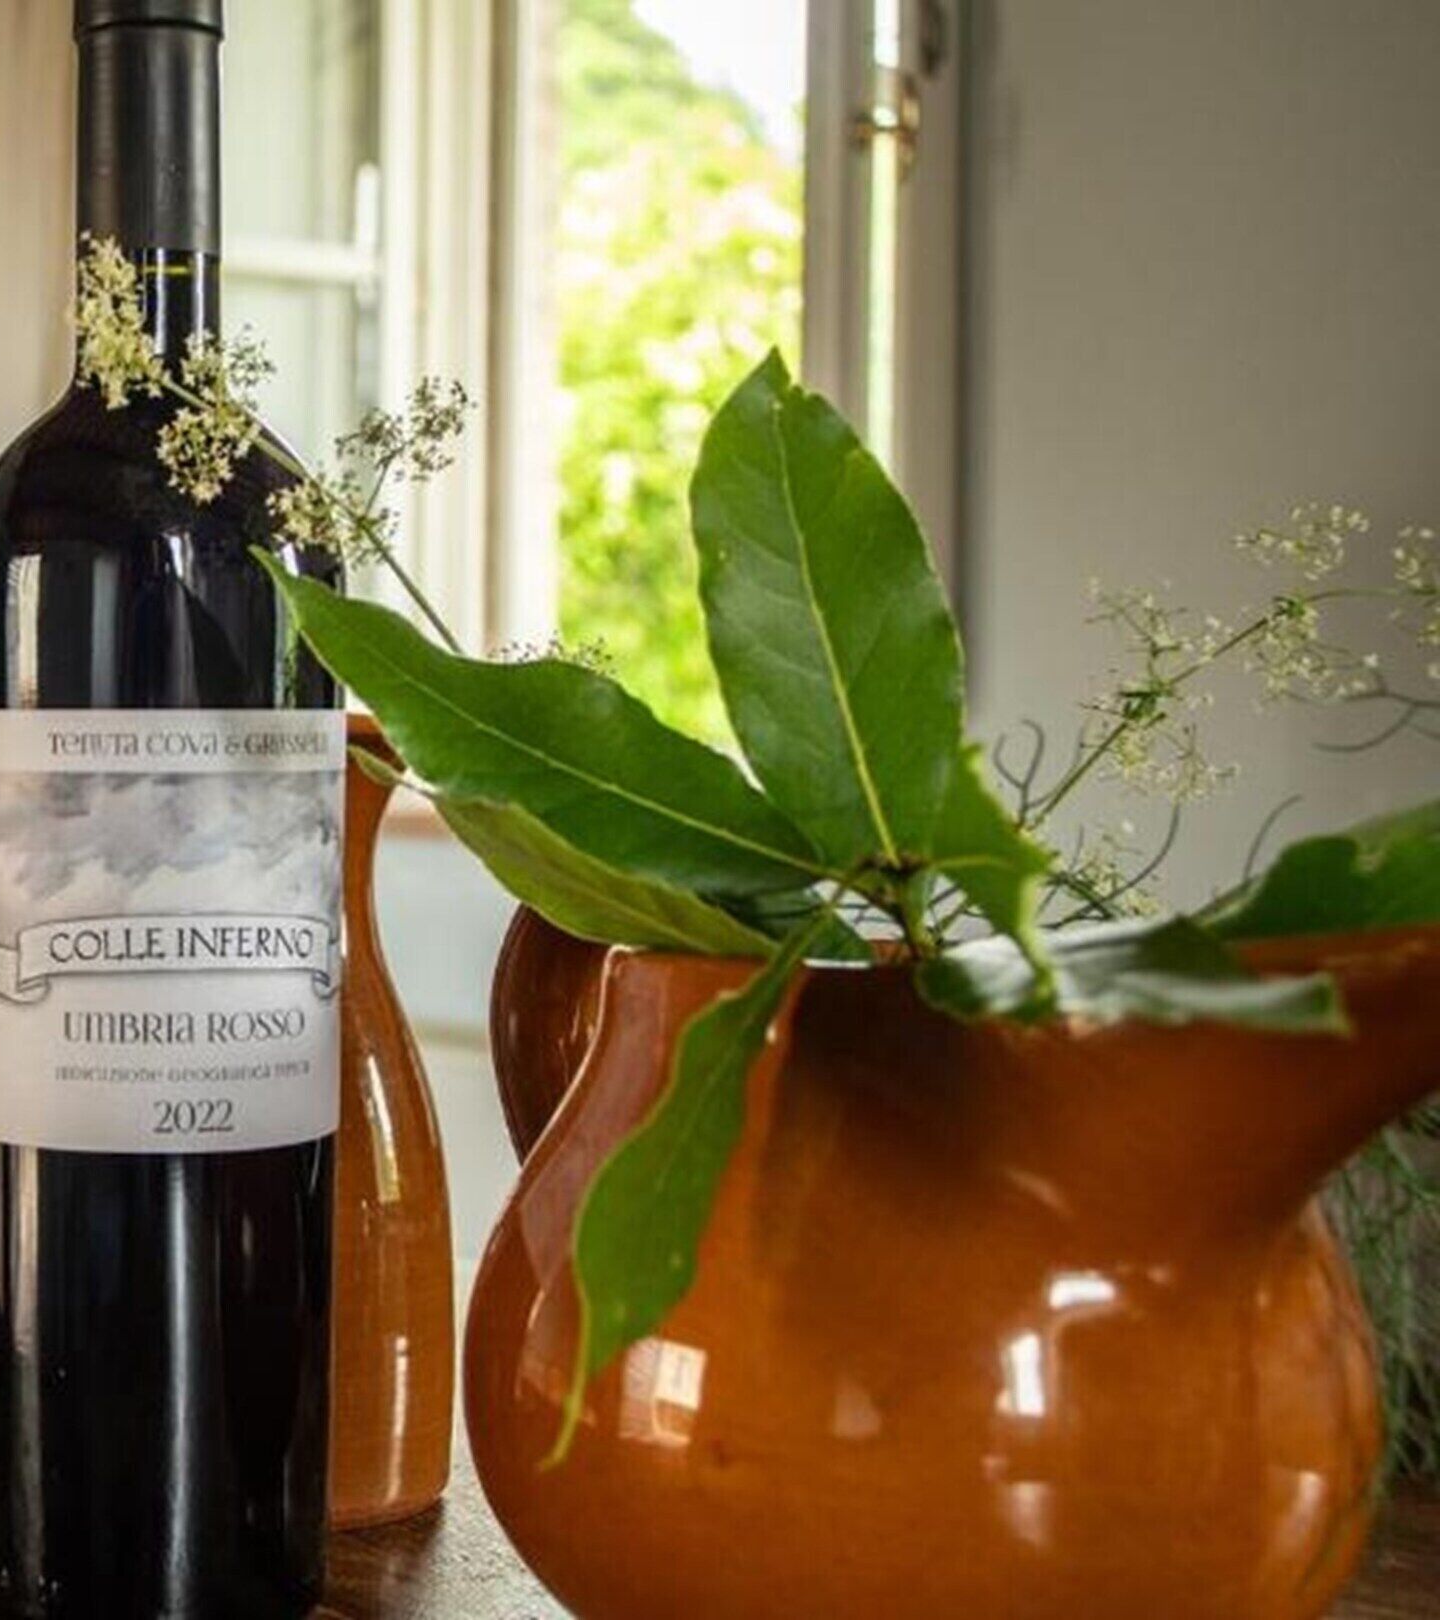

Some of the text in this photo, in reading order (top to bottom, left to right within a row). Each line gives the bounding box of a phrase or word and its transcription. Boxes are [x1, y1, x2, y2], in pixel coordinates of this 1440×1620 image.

[223, 733, 241, 756] &
[49, 926, 315, 963] COLLE INFERNO
[207, 1008, 306, 1043] ROSSO
[153, 1099, 235, 1133] 2022
